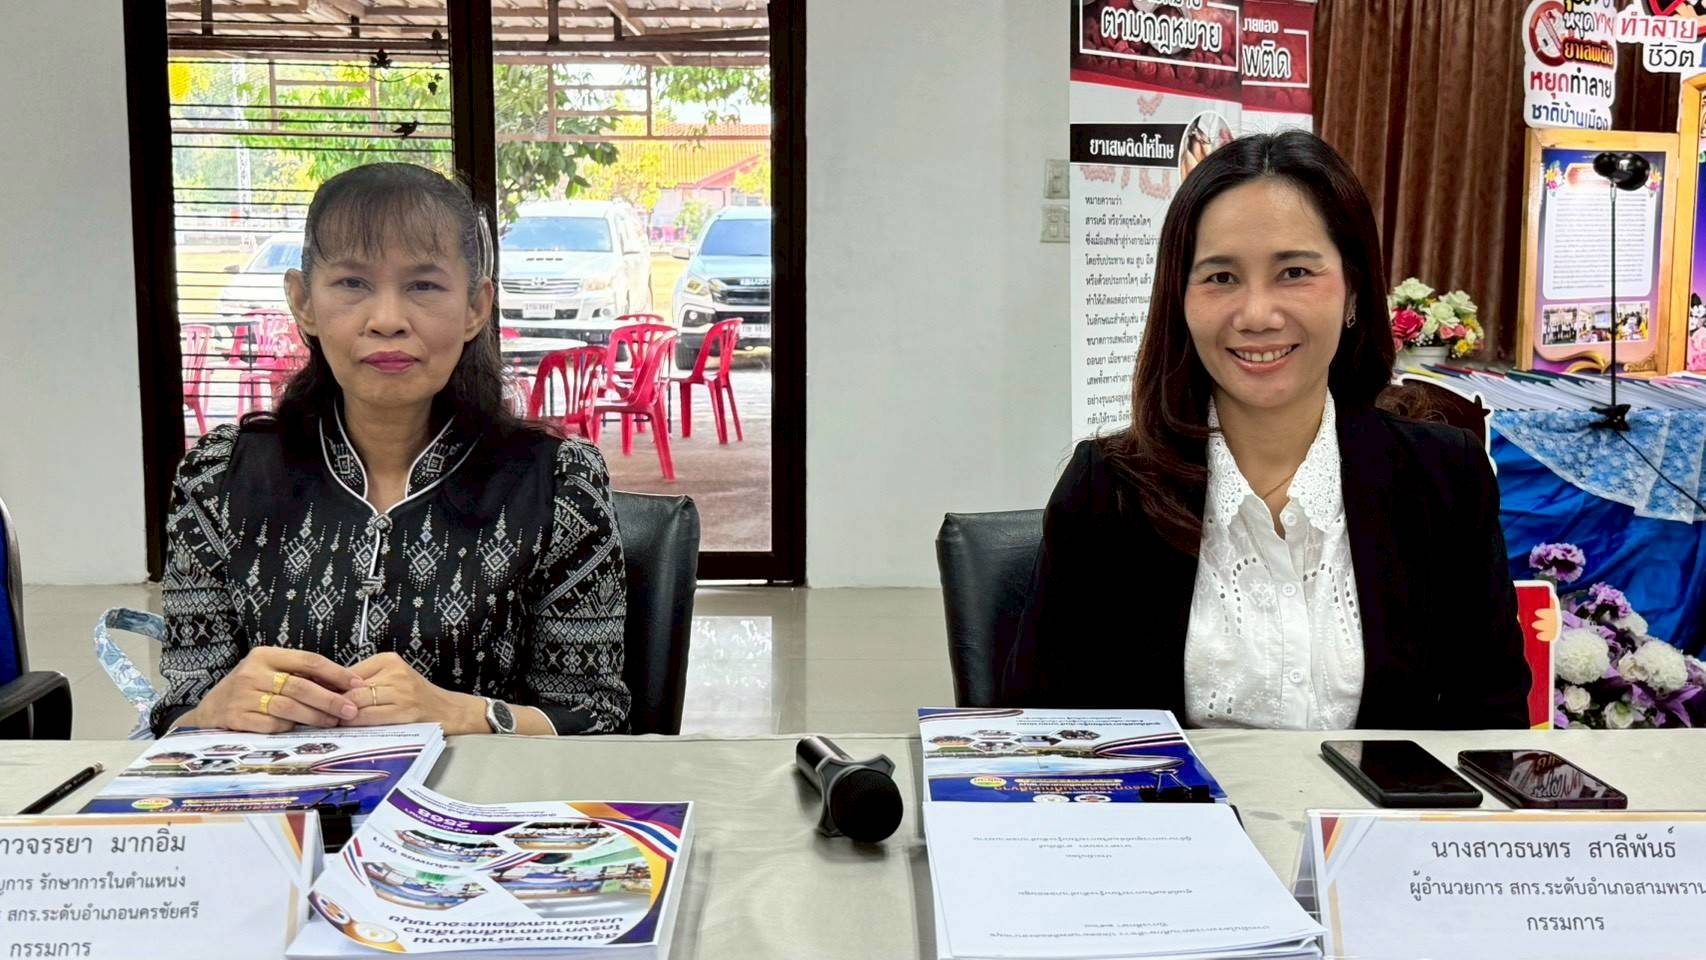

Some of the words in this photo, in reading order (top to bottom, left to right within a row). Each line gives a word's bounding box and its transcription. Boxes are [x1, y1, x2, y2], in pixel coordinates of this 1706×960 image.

[1101, 6, 1222, 54] ตามกฎหมาย
[1621, 11, 1696, 39] ทำลาย
[1564, 41, 1614, 65] ยาเสพติด
[1648, 42, 1695, 67] ชีวิต
[1530, 67, 1612, 99] หยุดทำลาย
[1531, 101, 1608, 130] ชาติบ้านเมือง
[1089, 132, 1175, 160] ยาเสพติดให้โทษ
[110, 821, 187, 854] มากอิ่ม
[1431, 837, 1571, 860] นางสาวธนทร
[1587, 826, 1677, 860] สาลีพันธ์
[39, 867, 187, 891] รักษาการในตำแหน่ง
[1409, 870, 1504, 902] ผู้อำนวยการ
[7, 900, 200, 922] สกร.ระดับอำเภอนครชัยศรี
[1526, 914, 1606, 932] กรรมการ
[9, 939, 92, 957] กรรมการ
